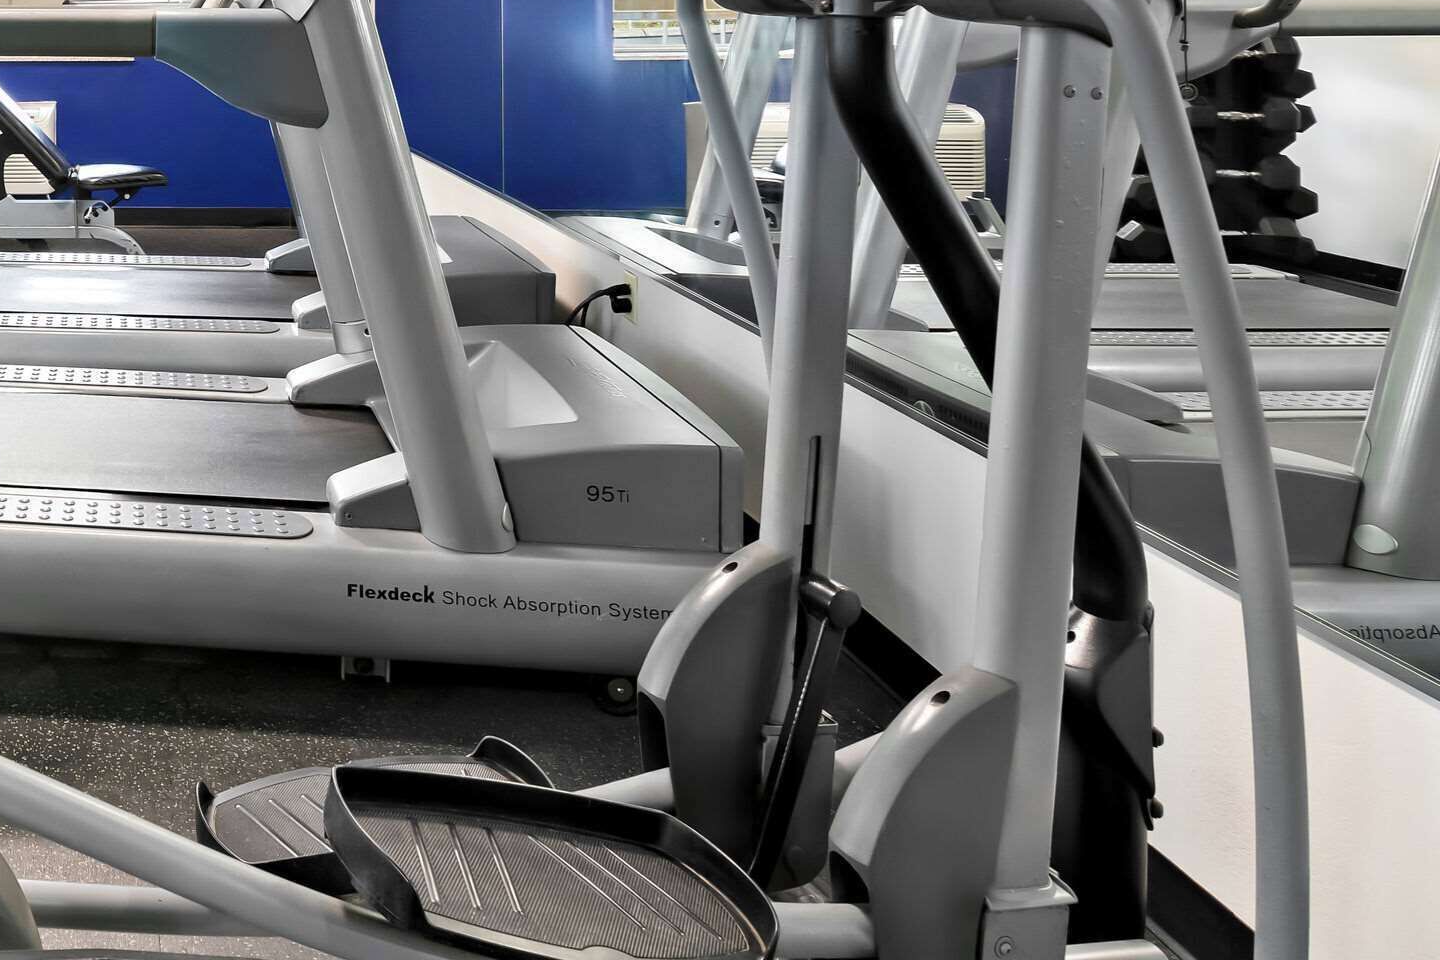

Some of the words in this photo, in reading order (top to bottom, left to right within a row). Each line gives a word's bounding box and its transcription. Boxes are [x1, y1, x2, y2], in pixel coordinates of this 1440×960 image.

[586, 485, 630, 503] 95Ti
[347, 583, 435, 604] Flexdeck
[442, 590, 498, 609] Shock
[503, 595, 601, 617] Absorption
